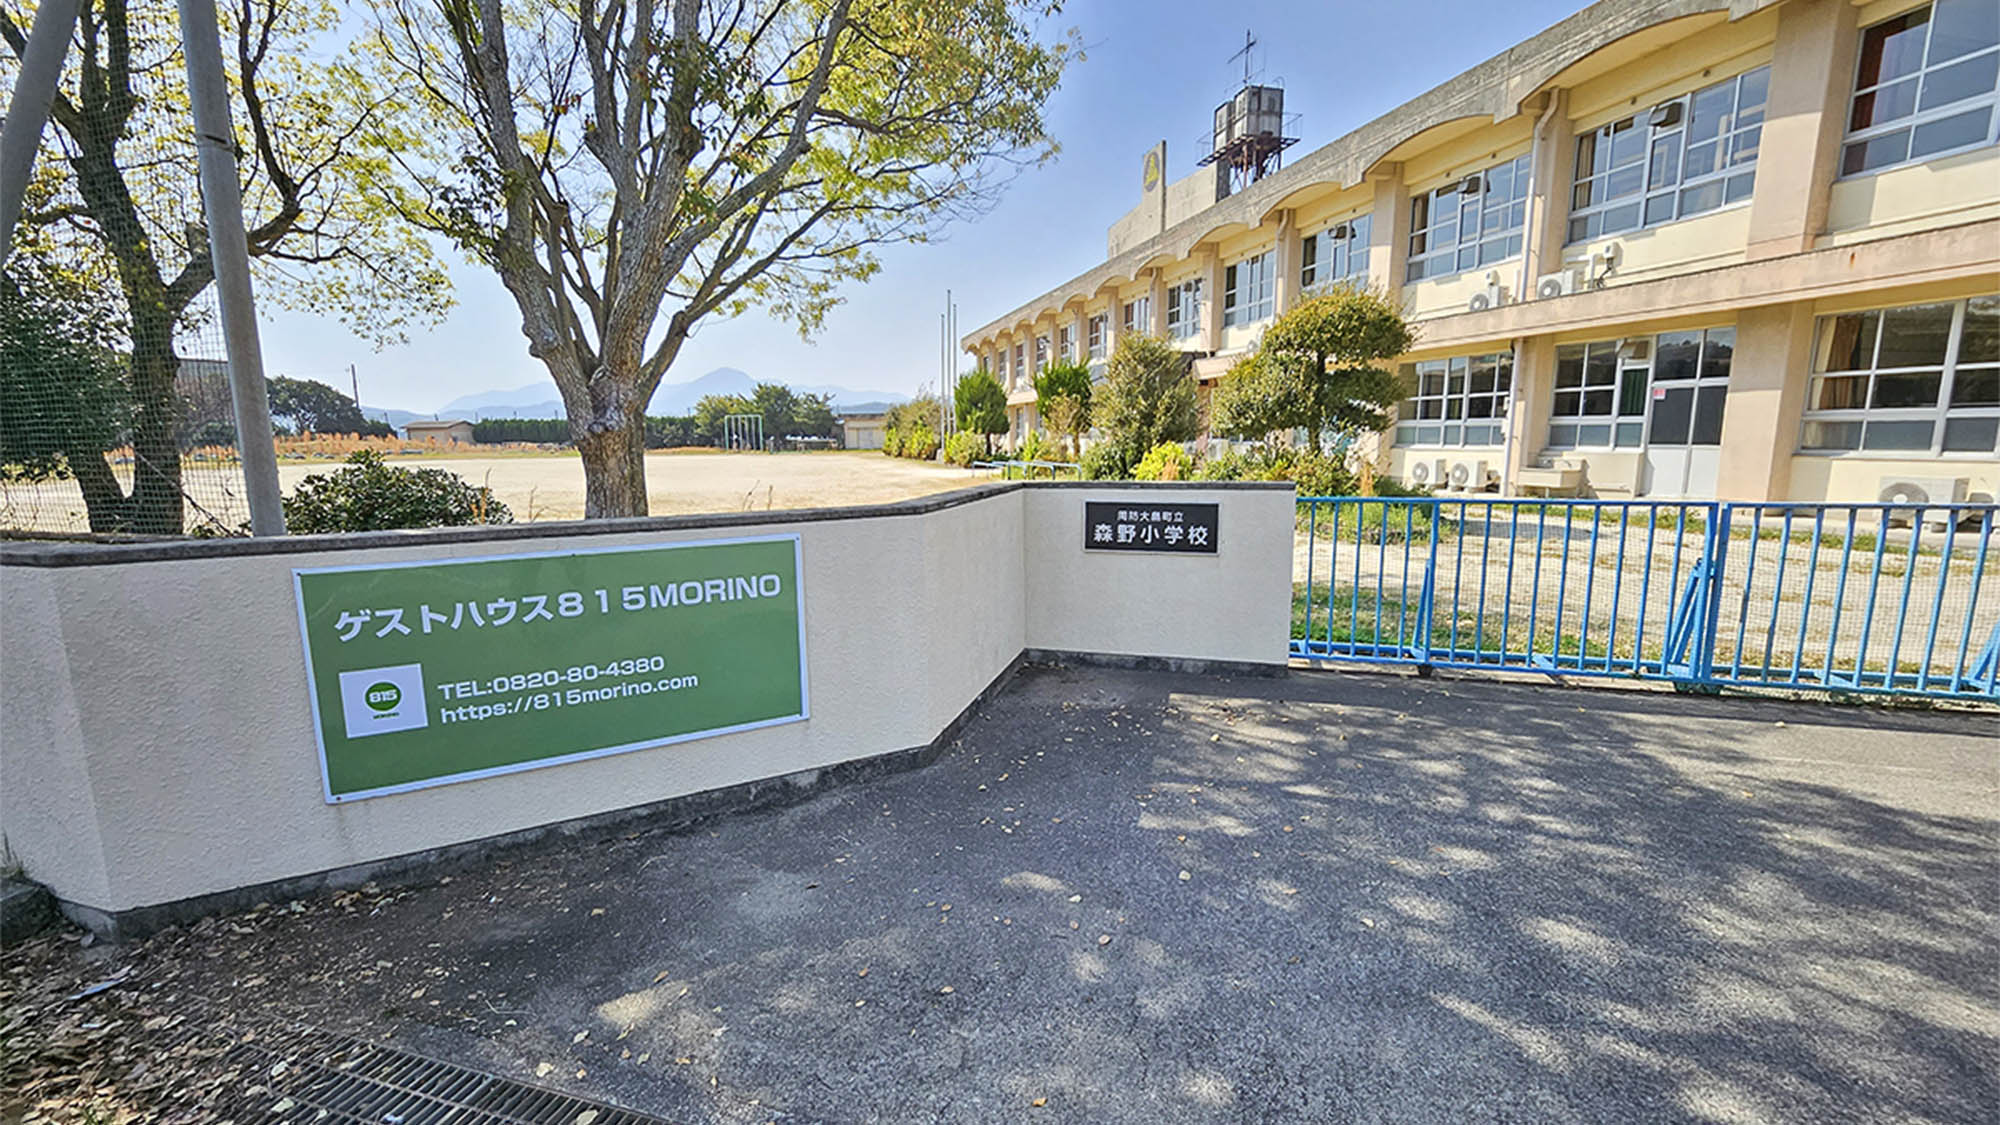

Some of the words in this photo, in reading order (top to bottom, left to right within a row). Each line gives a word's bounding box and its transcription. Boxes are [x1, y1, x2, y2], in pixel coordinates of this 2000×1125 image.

[1093, 523, 1209, 546] 森野小学校
[437, 655, 665, 700] TEL:0820-80-4380
[369, 688, 398, 703] 815
[440, 675, 699, 724] https://815morino.com
